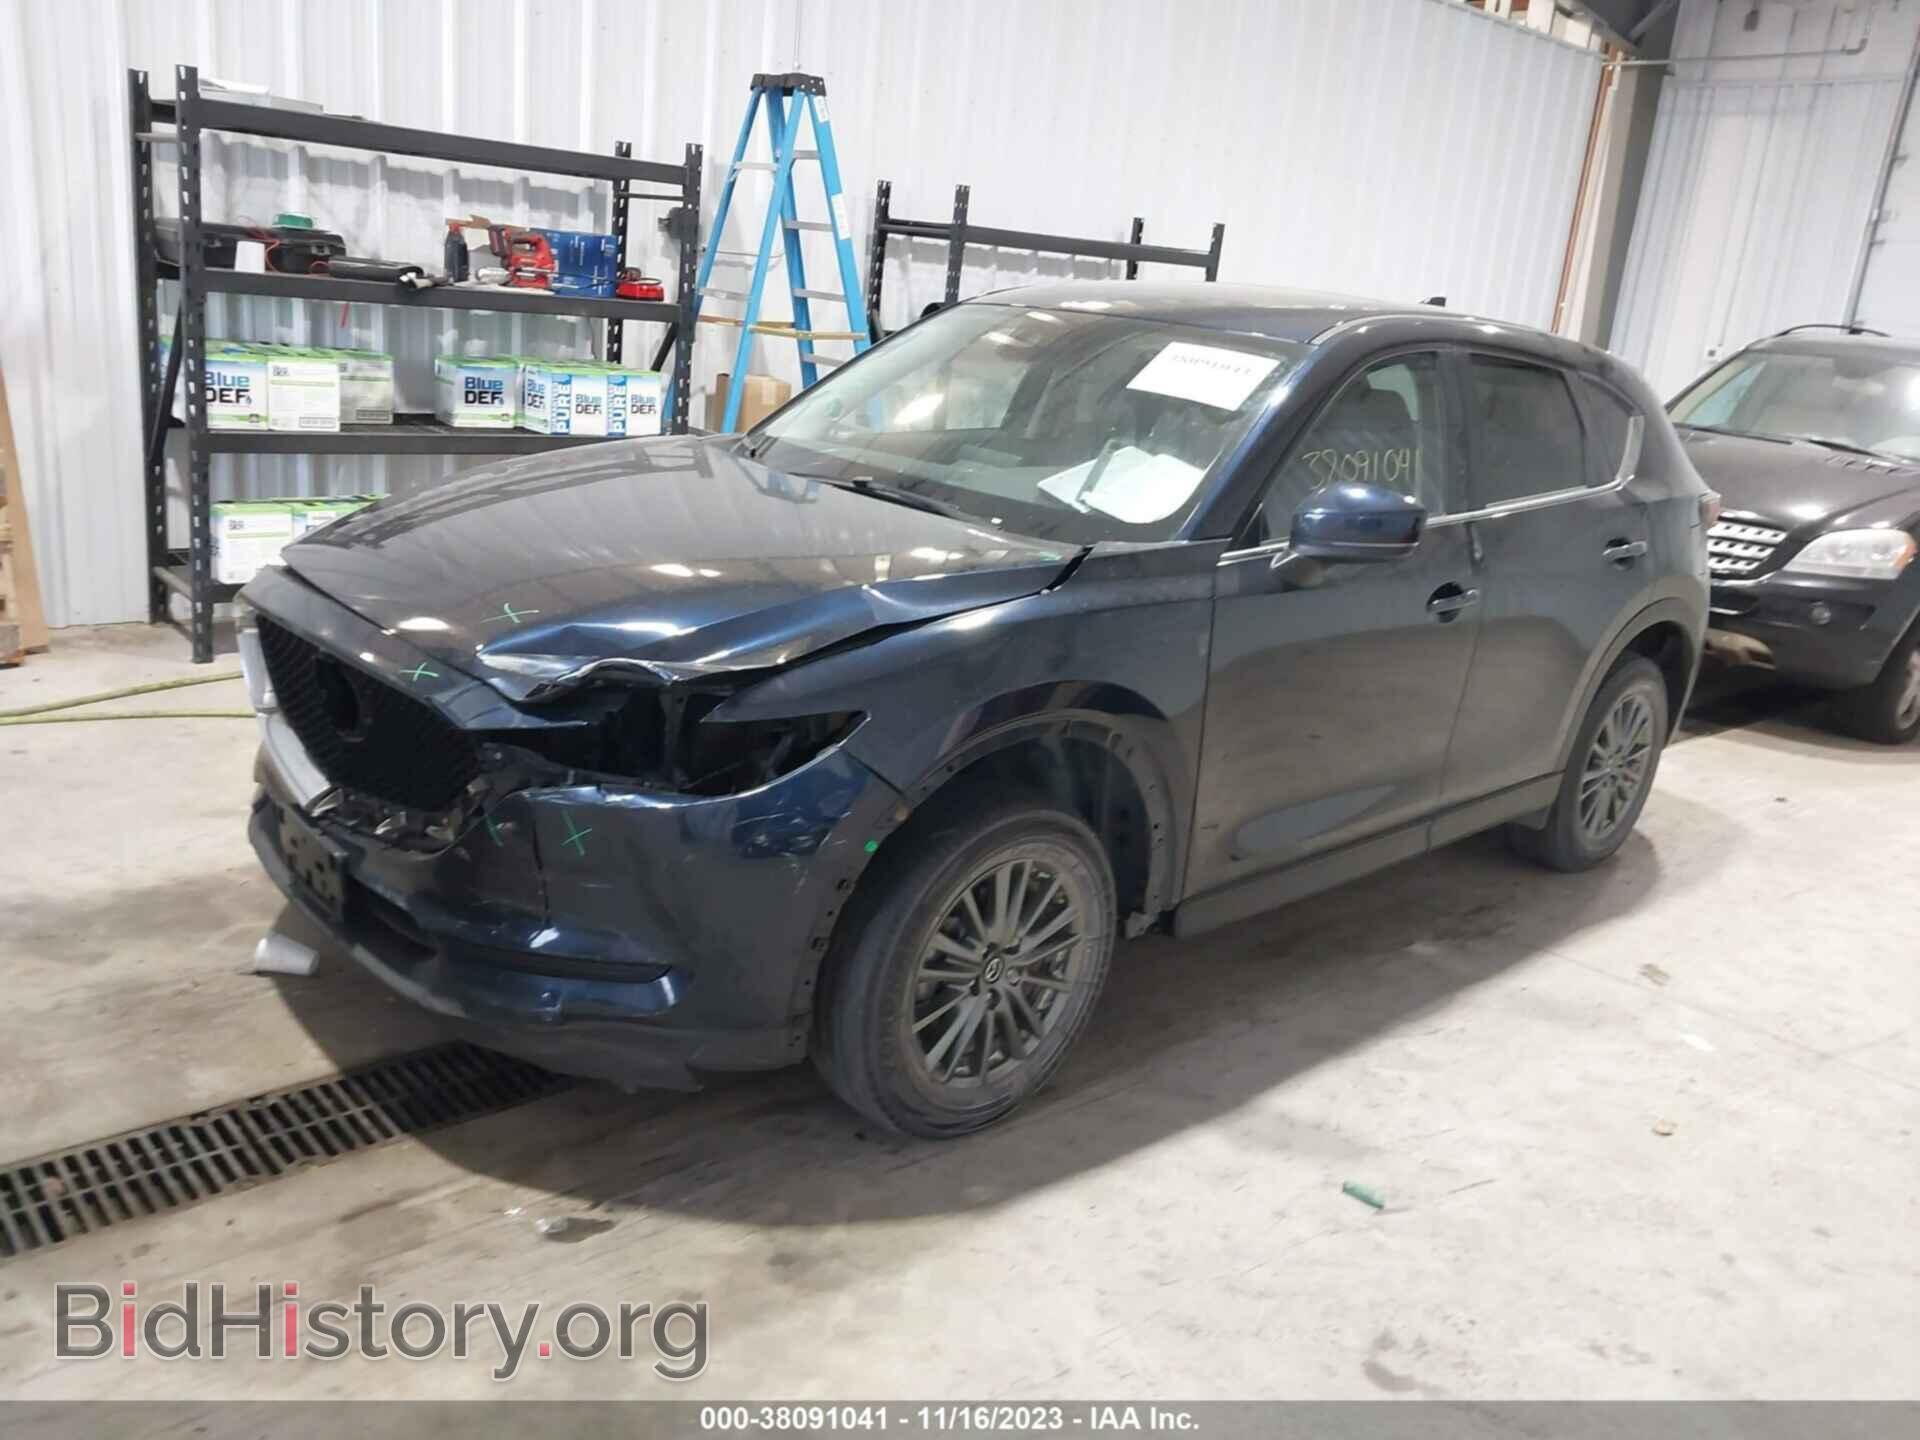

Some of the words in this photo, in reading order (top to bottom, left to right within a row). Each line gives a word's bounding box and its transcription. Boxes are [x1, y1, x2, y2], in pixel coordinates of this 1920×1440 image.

[204, 371, 250, 387] Blue
[464, 376, 504, 390] Blue
[205, 387, 250, 404] DEF
[464, 390, 503, 404] DEF
[575, 393, 602, 403] Blue
[630, 394, 657, 404] Blue
[556, 384, 571, 433] PURE
[575, 403, 602, 414] DEF
[611, 384, 626, 433] PURE
[630, 404, 657, 414] DEF
